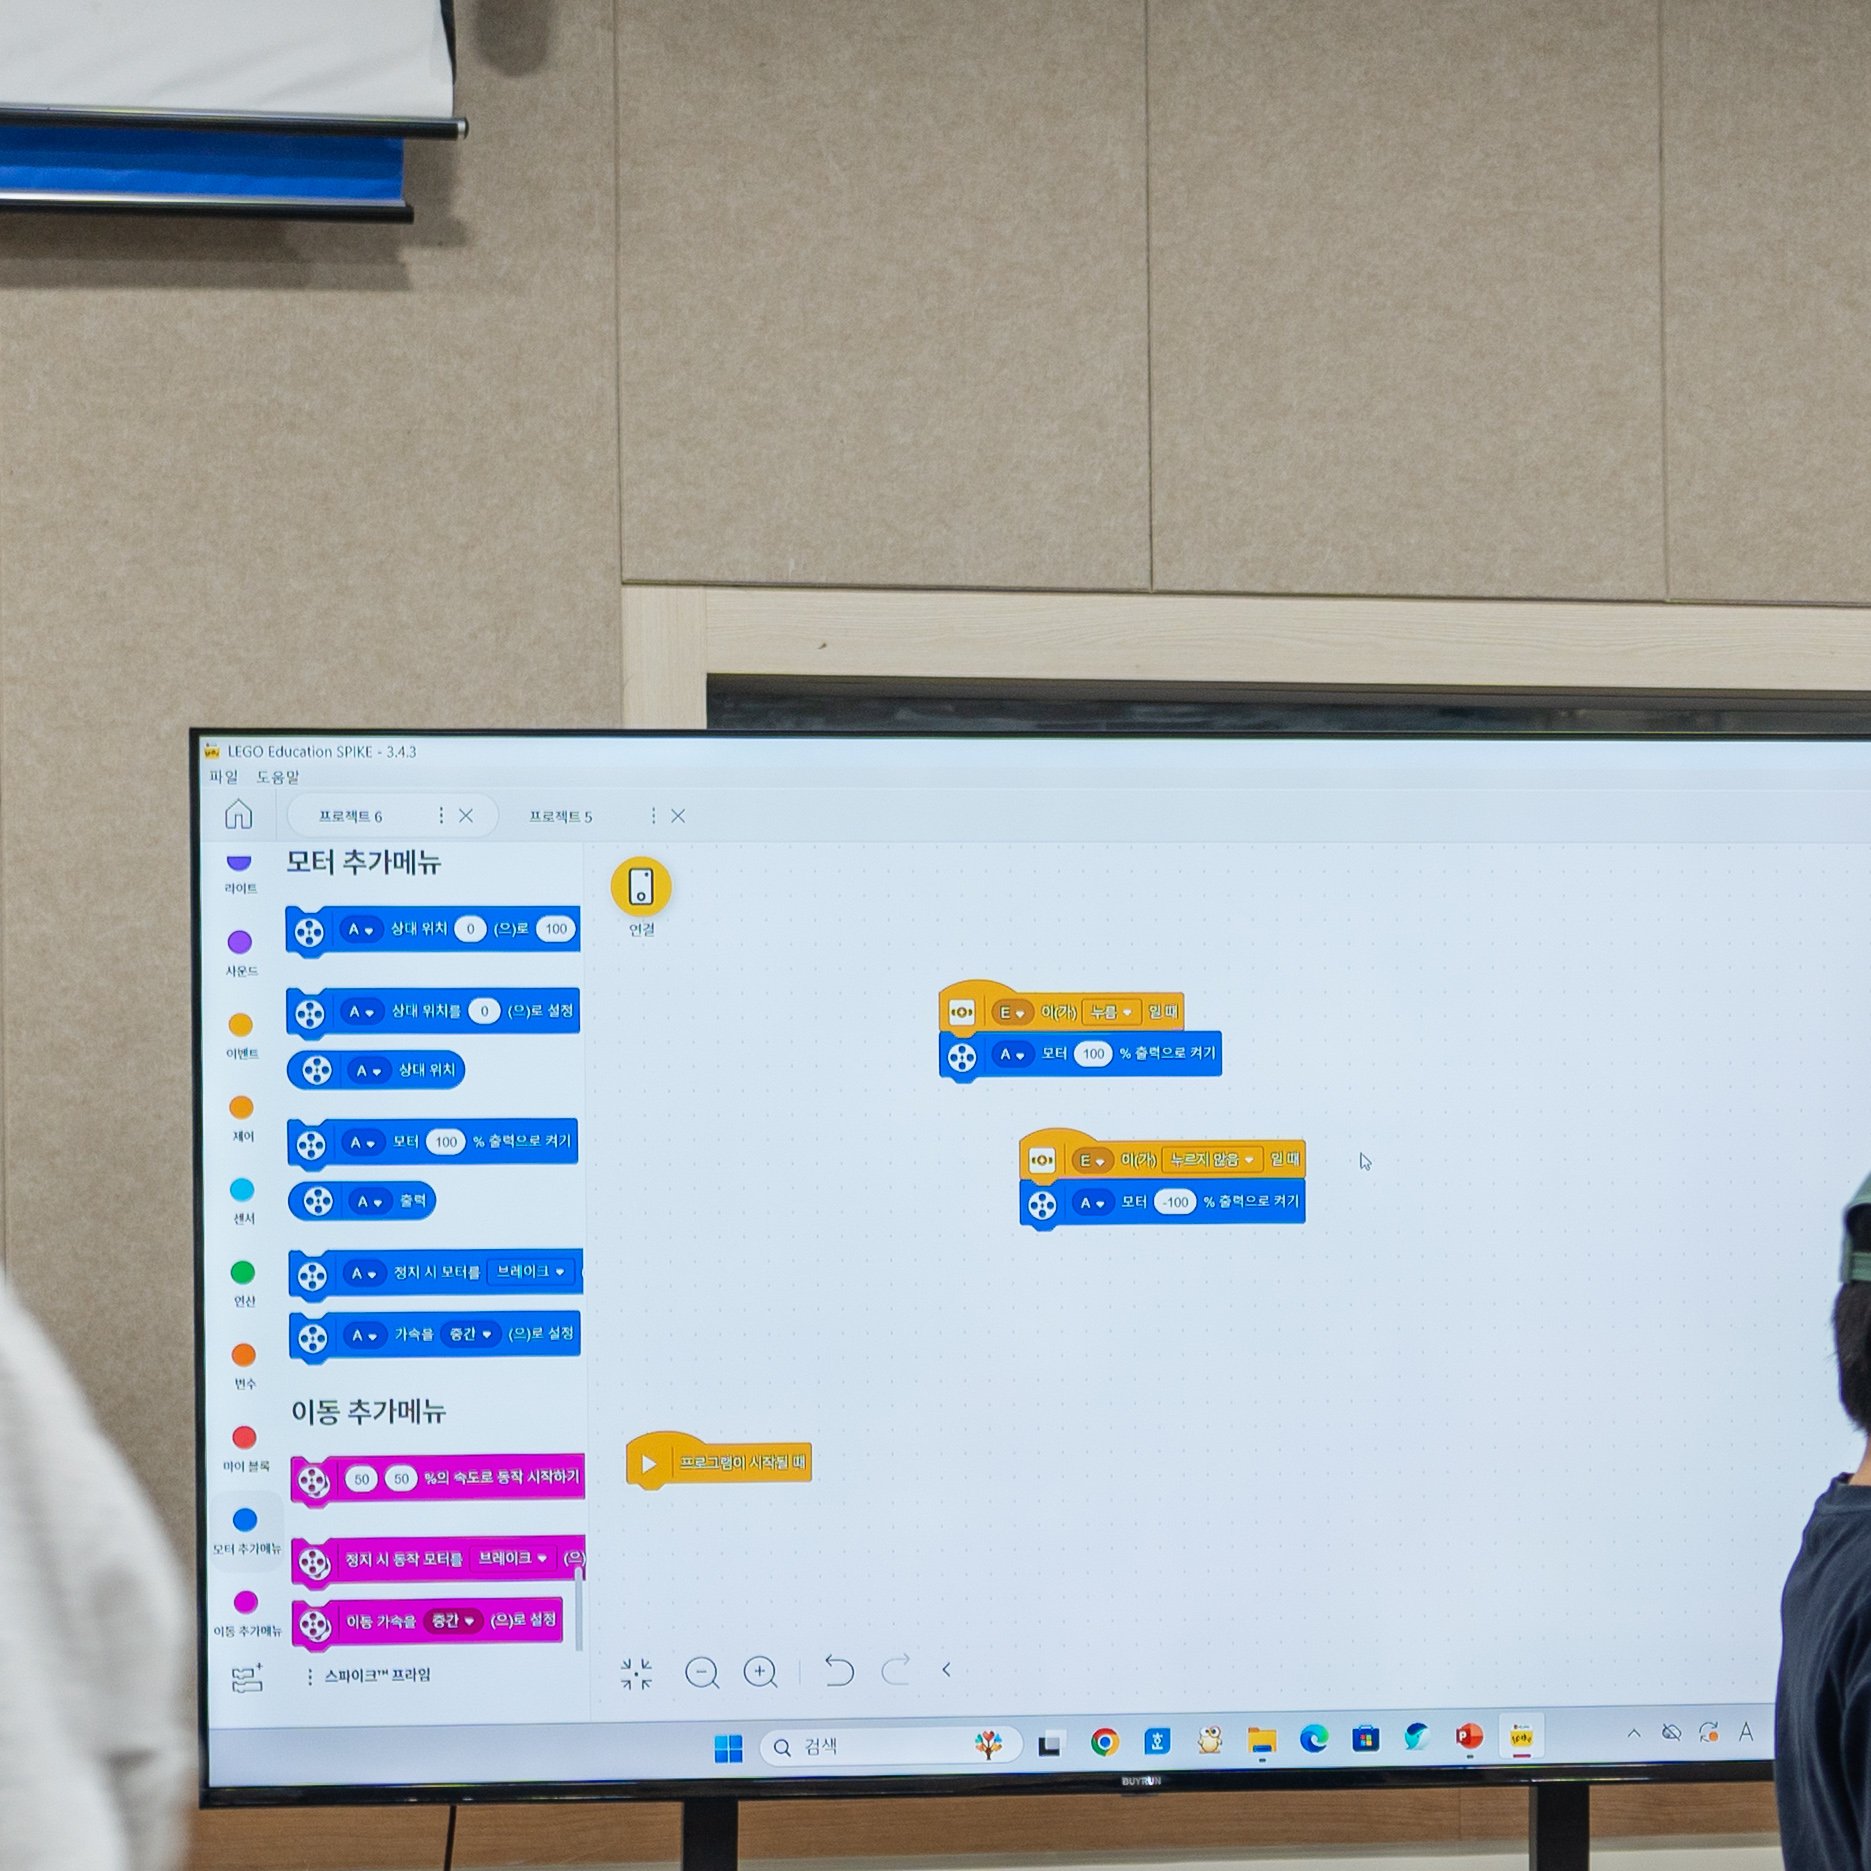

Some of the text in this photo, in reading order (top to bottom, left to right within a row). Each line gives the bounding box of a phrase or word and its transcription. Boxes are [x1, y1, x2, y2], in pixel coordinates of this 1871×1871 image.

[228, 746, 263, 757] LEGO
[269, 746, 332, 757] Education
[337, 746, 372, 757] SPIKE
[387, 746, 416, 758] 3.4.3
[210, 770, 238, 785] 파일
[257, 770, 299, 785] 도움말
[320, 810, 382, 823] 프로젝트 6
[530, 810, 593, 824] 프로젝트 5
[288, 850, 442, 876] 모터 추가메뉴
[225, 882, 257, 895] 라이트
[348, 921, 567, 937] A 상대 위치 0 (으)로 100
[630, 923, 655, 937] 연결
[226, 965, 258, 977] 사운드
[349, 1003, 573, 1019] A 상대 위치를 0 (으)로 설정
[1001, 1007, 1010, 1018] E
[1149, 1005, 1162, 1020] 일
[1165, 1005, 1178, 1019] 때
[226, 1047, 259, 1059] 이벤트
[1001, 1046, 1216, 1061] A 모터 100 % 출력으로 켜기
[356, 1062, 455, 1078] A 상대 위치
[233, 1131, 255, 1143] 제어
[351, 1133, 571, 1149] A 모터 100 % 출력으로 켜기
[1081, 1156, 1090, 1166] E
[1271, 1153, 1284, 1167] 일
[1287, 1152, 1300, 1166] 때
[358, 1193, 426, 1208] A 출력
[1081, 1194, 1299, 1209] A 모터 -100 % 출력으로 켜기
[233, 1213, 255, 1225] 센서
[352, 1263, 550, 1280] A 정지 시 모터를 브레이크
[234, 1295, 255, 1307] 연산
[353, 1325, 573, 1343] A 가속을 중간 (으)로 설정
[235, 1378, 256, 1390] 변수
[292, 1399, 447, 1425] 이동 추가메뉴
[223, 1460, 270, 1473] 마이 블록
[680, 1455, 745, 1471] 프로그램이
[793, 1454, 805, 1470] 때
[355, 1468, 580, 1485] 50 50 %의 속도로 동작 시작하기
[213, 1543, 235, 1556] 모터
[346, 1552, 372, 1567] 정지
[376, 1552, 389, 1567] 시
[393, 1552, 420, 1567] 동작
[478, 1551, 532, 1566] 브레이크
[346, 1615, 373, 1629] 이동
[490, 1613, 526, 1629] (으)로
[530, 1612, 556, 1628] 설정
[213, 1625, 235, 1638] 이동
[392, 1667, 431, 1682] 프라임
[805, 1737, 838, 1757] 검색
